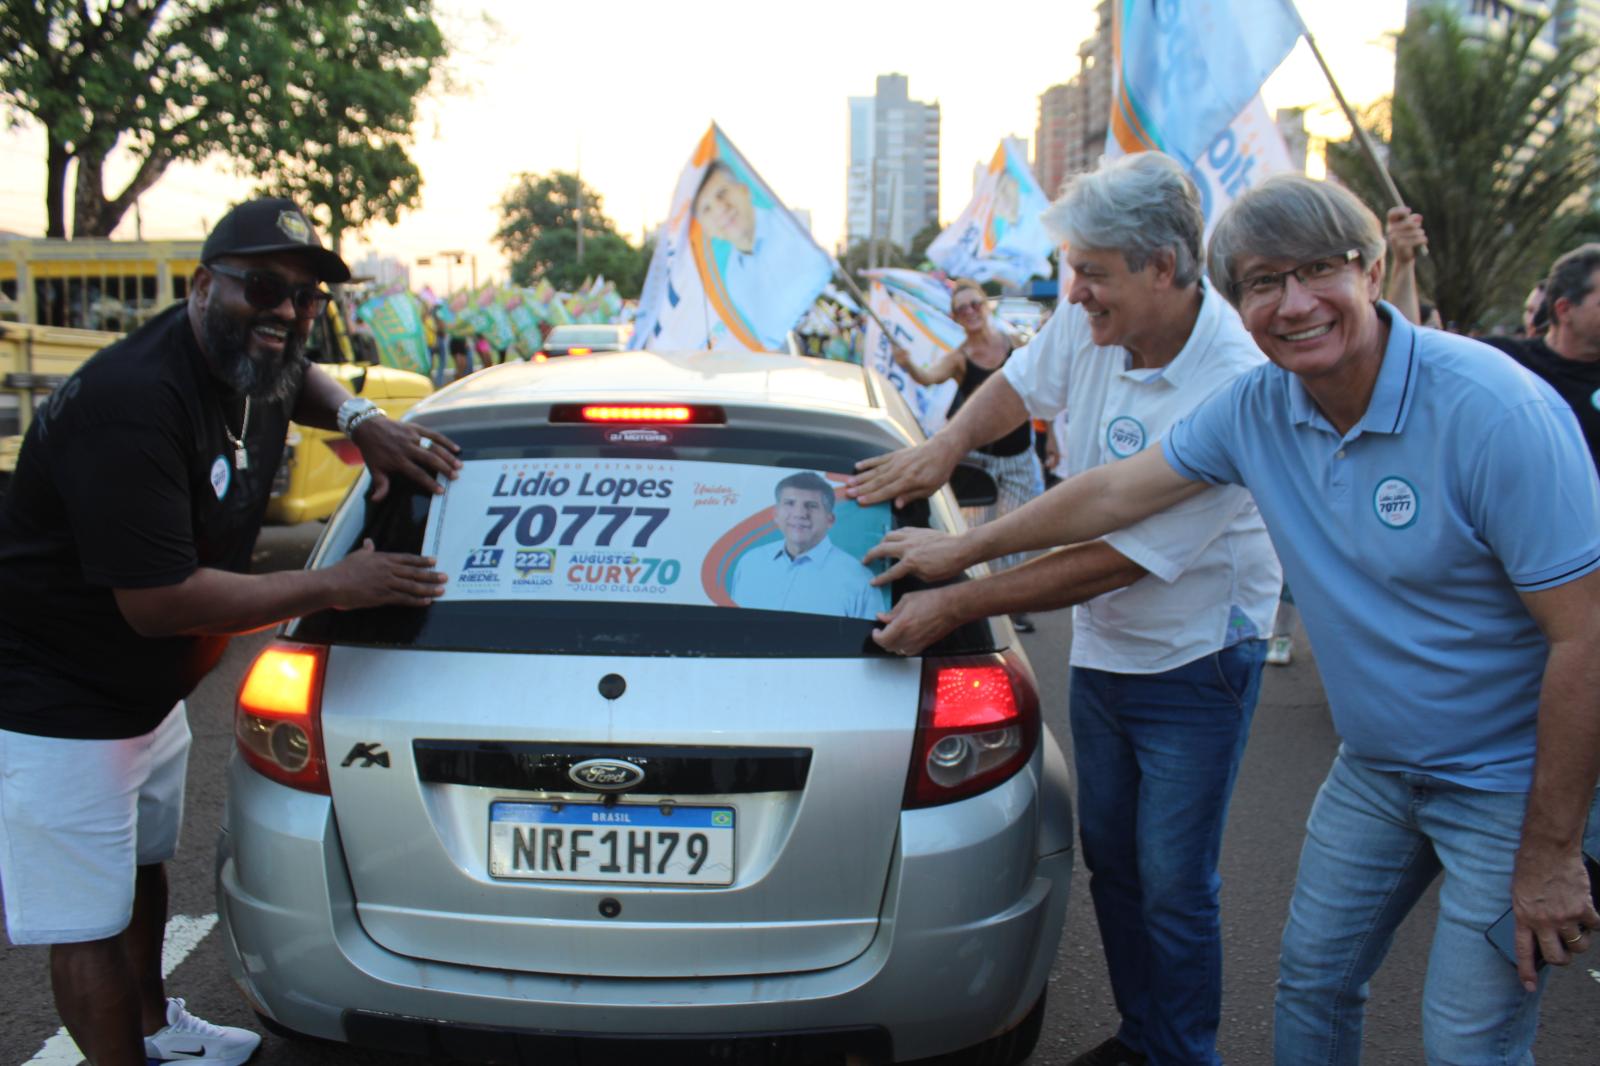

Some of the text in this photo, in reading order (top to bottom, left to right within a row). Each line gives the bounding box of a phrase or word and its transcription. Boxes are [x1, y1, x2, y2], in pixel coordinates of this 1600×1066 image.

[577, 472, 674, 504] Lopes
[1380, 501, 1411, 512] 70777
[482, 505, 671, 547] 70777
[516, 552, 550, 567] 222
[567, 558, 682, 585] CURY 70
[611, 584, 667, 593] DELGADO
[586, 766, 627, 783] Ford
[591, 812, 632, 823] BRASIL
[512, 826, 710, 876] NRF1H79
